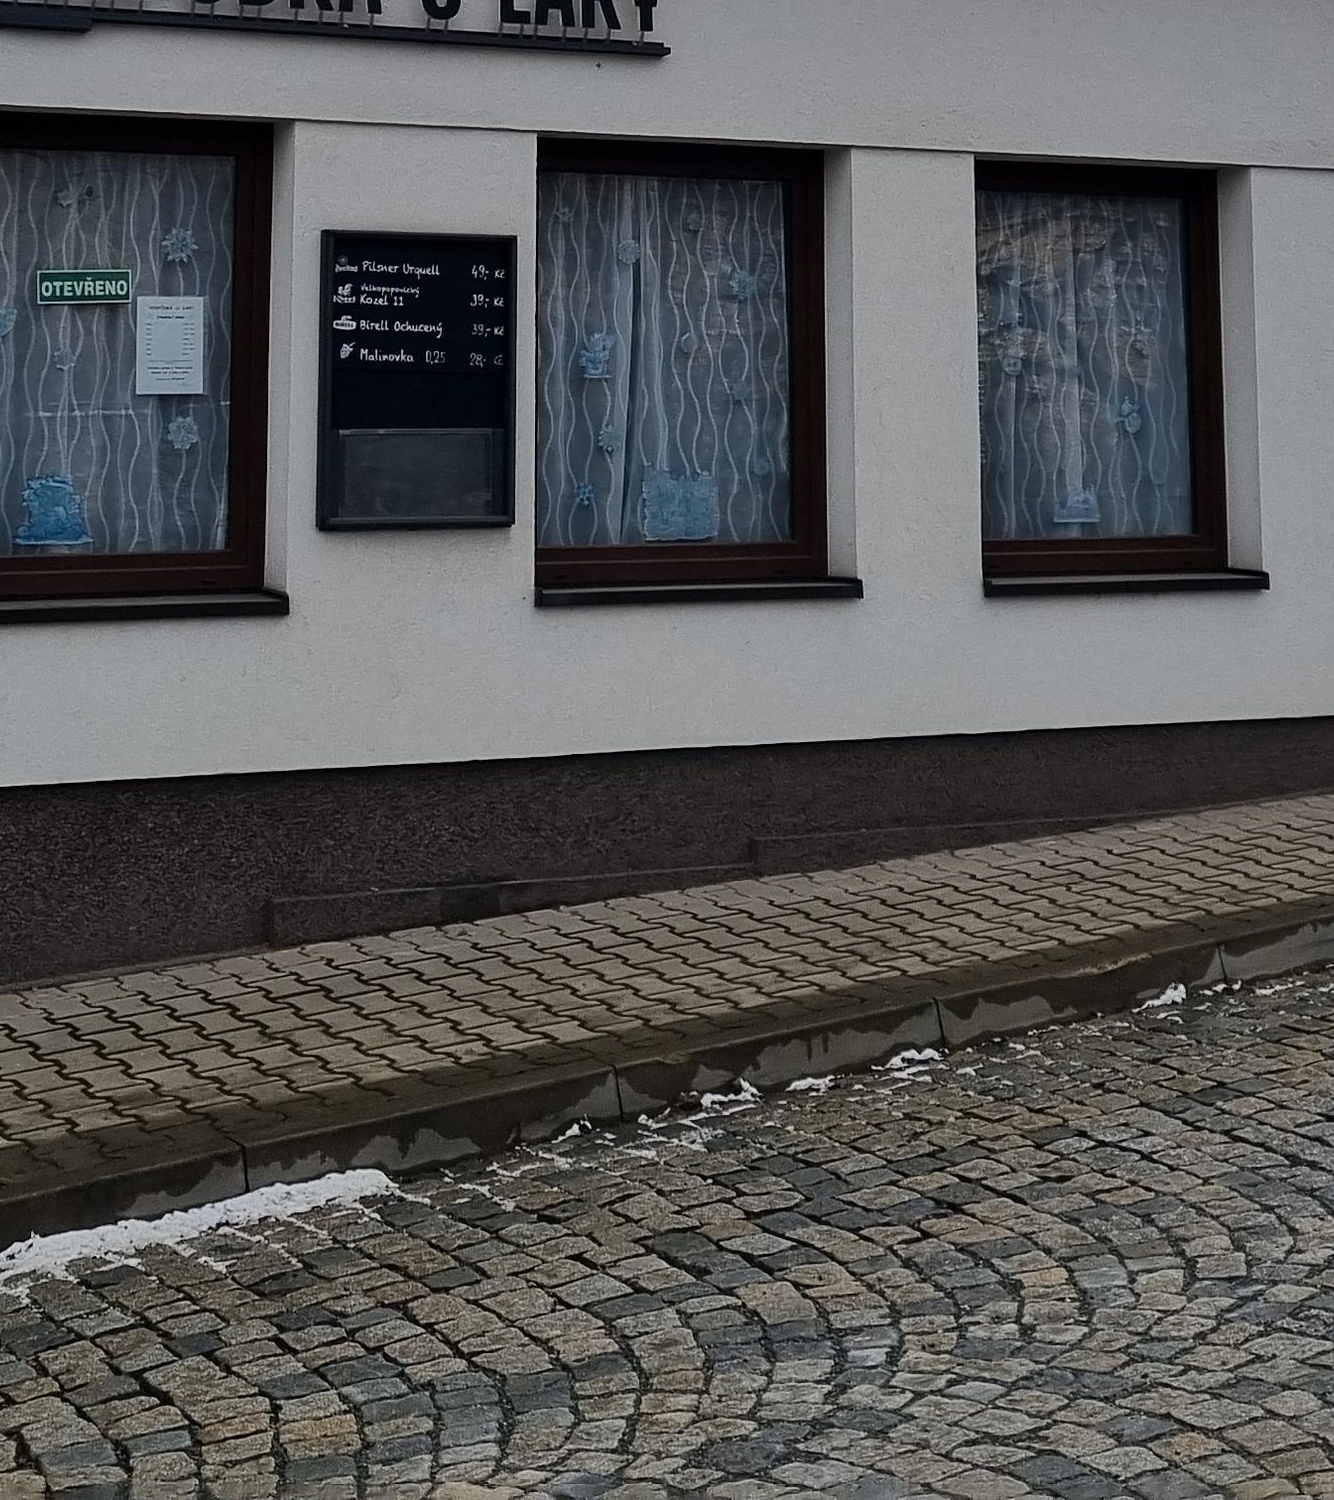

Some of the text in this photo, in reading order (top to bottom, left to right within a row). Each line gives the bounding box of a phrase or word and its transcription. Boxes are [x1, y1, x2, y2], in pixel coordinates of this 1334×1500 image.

[362, 260, 399, 273] Pilsner
[403, 263, 440, 280] Urquell
[41, 276, 127, 298] OTEVŘENO
[360, 293, 389, 306] Kozel
[393, 296, 404, 306] 11
[360, 320, 389, 331] Birell
[394, 321, 443, 339] Ochucený
[360, 348, 414, 362] Malinovka
[425, 349, 446, 365] 0,25
